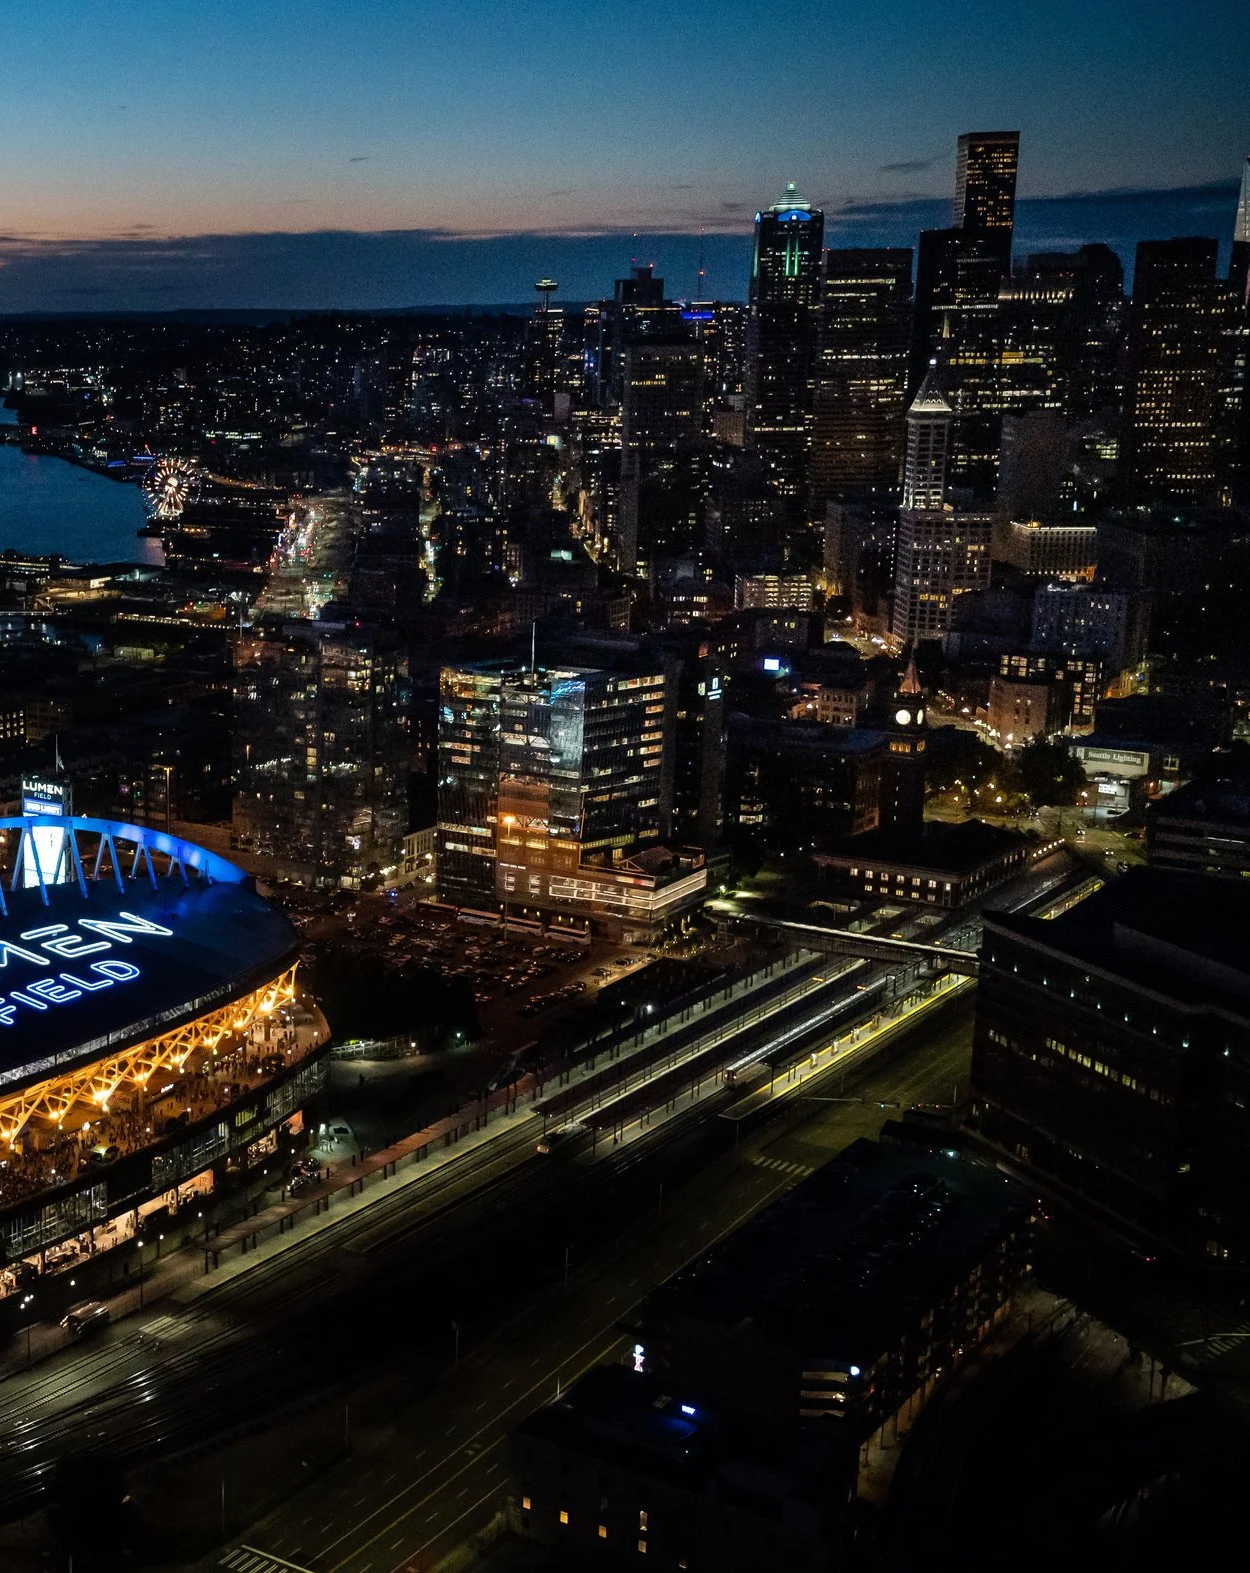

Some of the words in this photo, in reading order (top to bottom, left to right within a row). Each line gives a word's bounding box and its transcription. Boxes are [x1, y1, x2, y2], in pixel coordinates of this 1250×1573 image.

[1112, 753, 1141, 765] Lighting
[23, 780, 63, 795] LUMEN
[34, 791, 52, 800] FIELD
